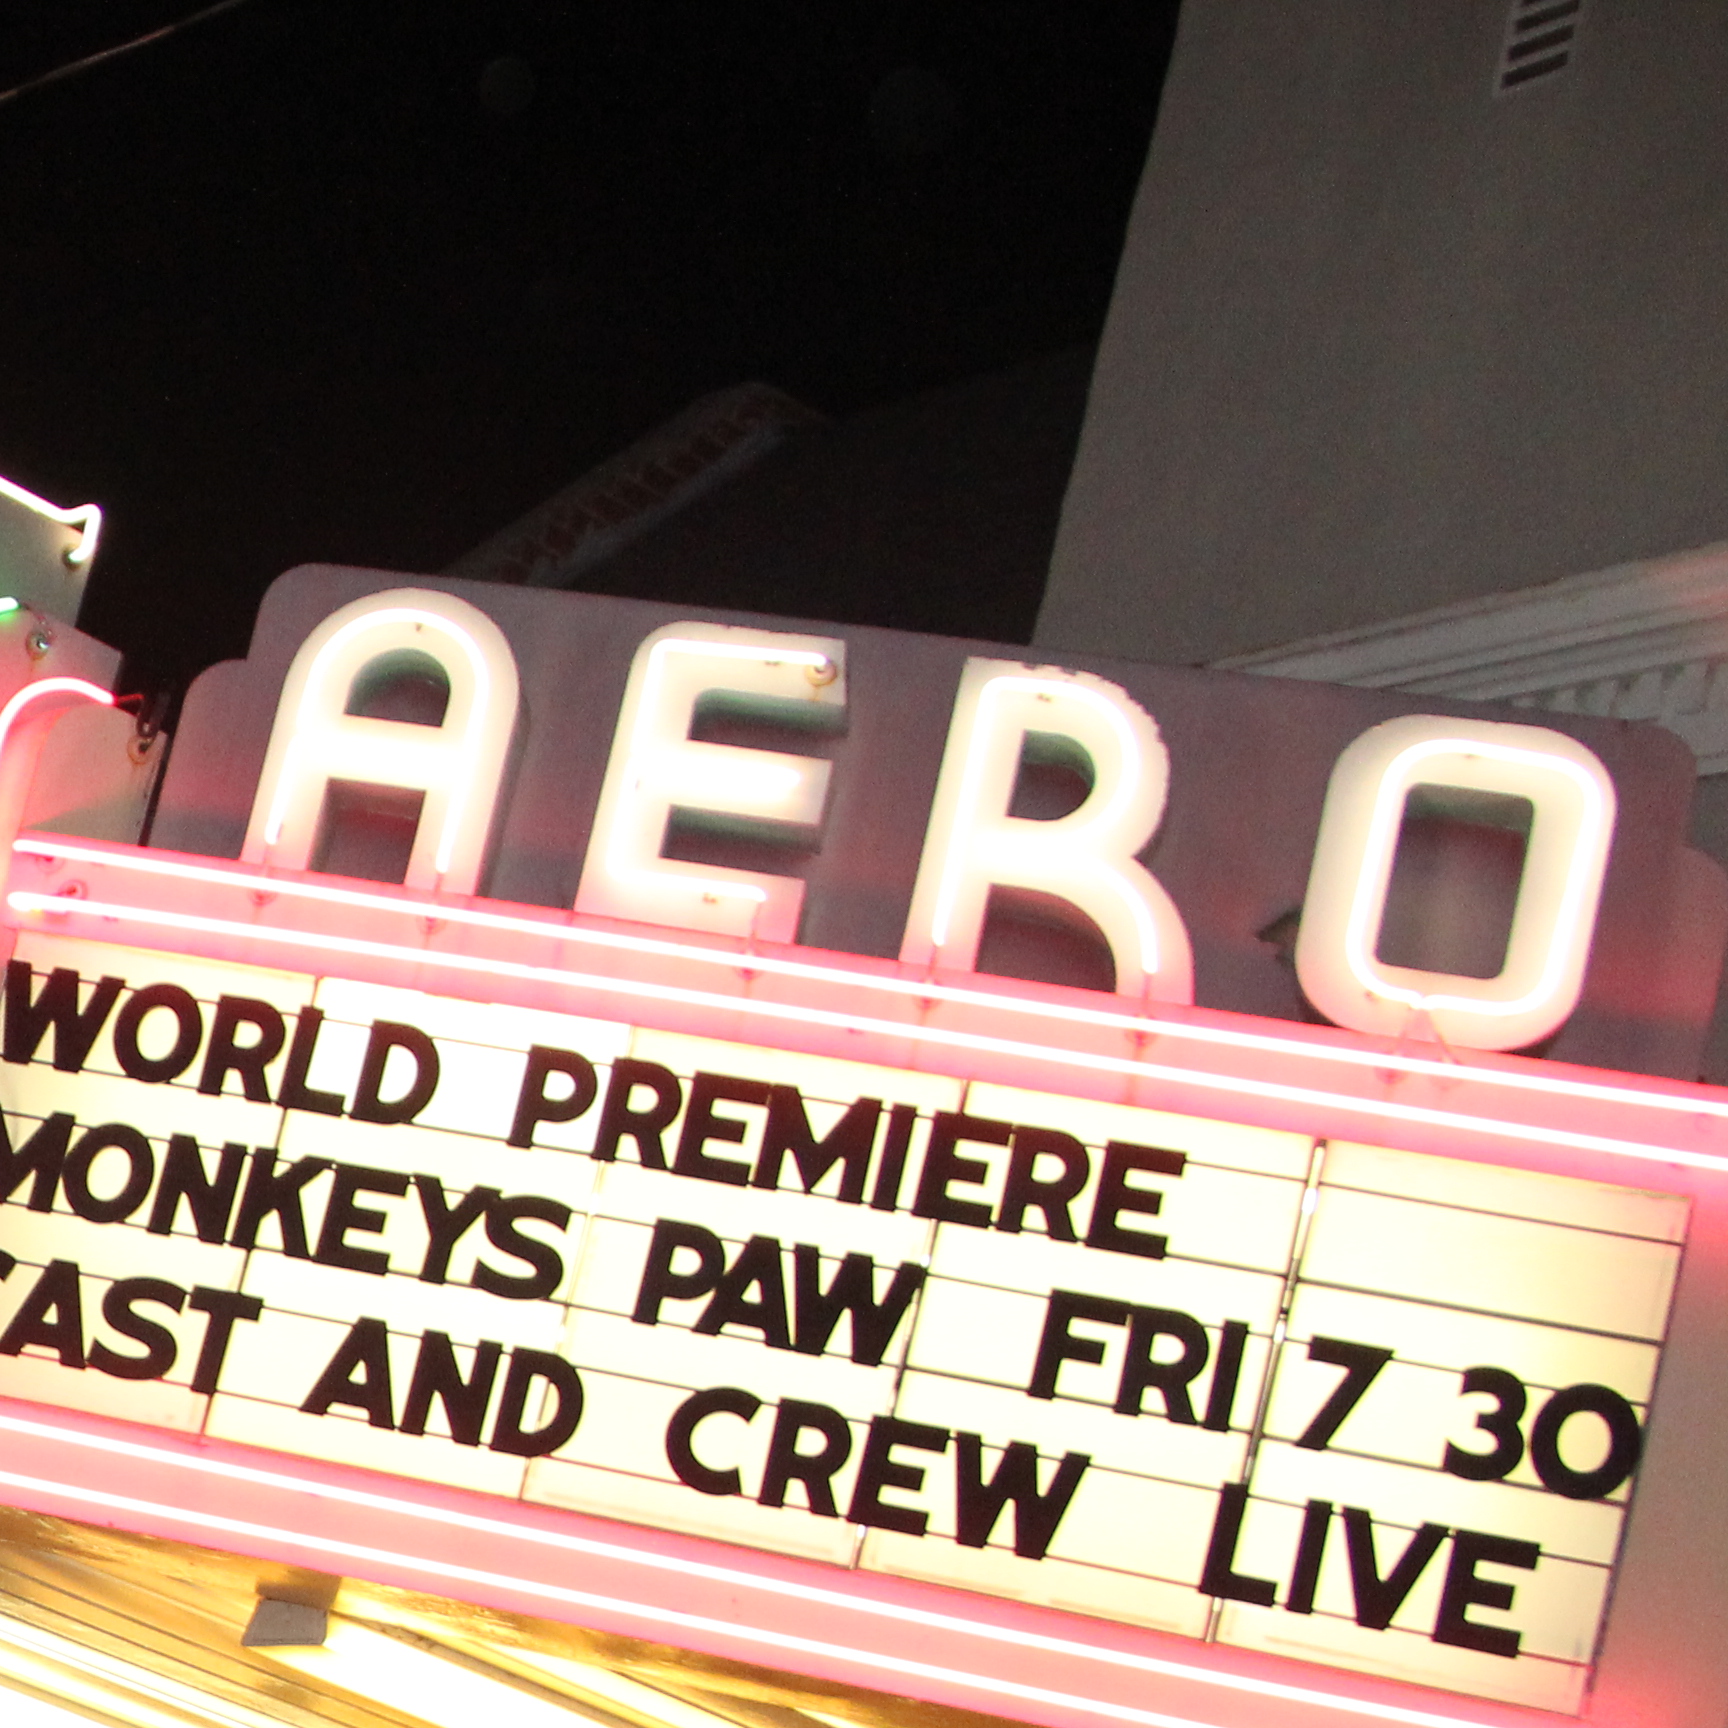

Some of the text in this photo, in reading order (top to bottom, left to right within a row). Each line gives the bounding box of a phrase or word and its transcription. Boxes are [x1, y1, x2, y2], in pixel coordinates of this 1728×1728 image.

[247, 587, 1617, 1050] AERO
[2, 960, 1185, 1259] WORLD PREMIERE
[305, 1317, 583, 1458] AND
[667, 1388, 1089, 1559] CREW
[1201, 1483, 1541, 1657] LIVE
[633, 1221, 925, 1366] PAW
[1030, 1291, 1248, 1432] FRI
[1300, 1336, 1392, 1450] 7
[1444, 1369, 1642, 1501] 30
